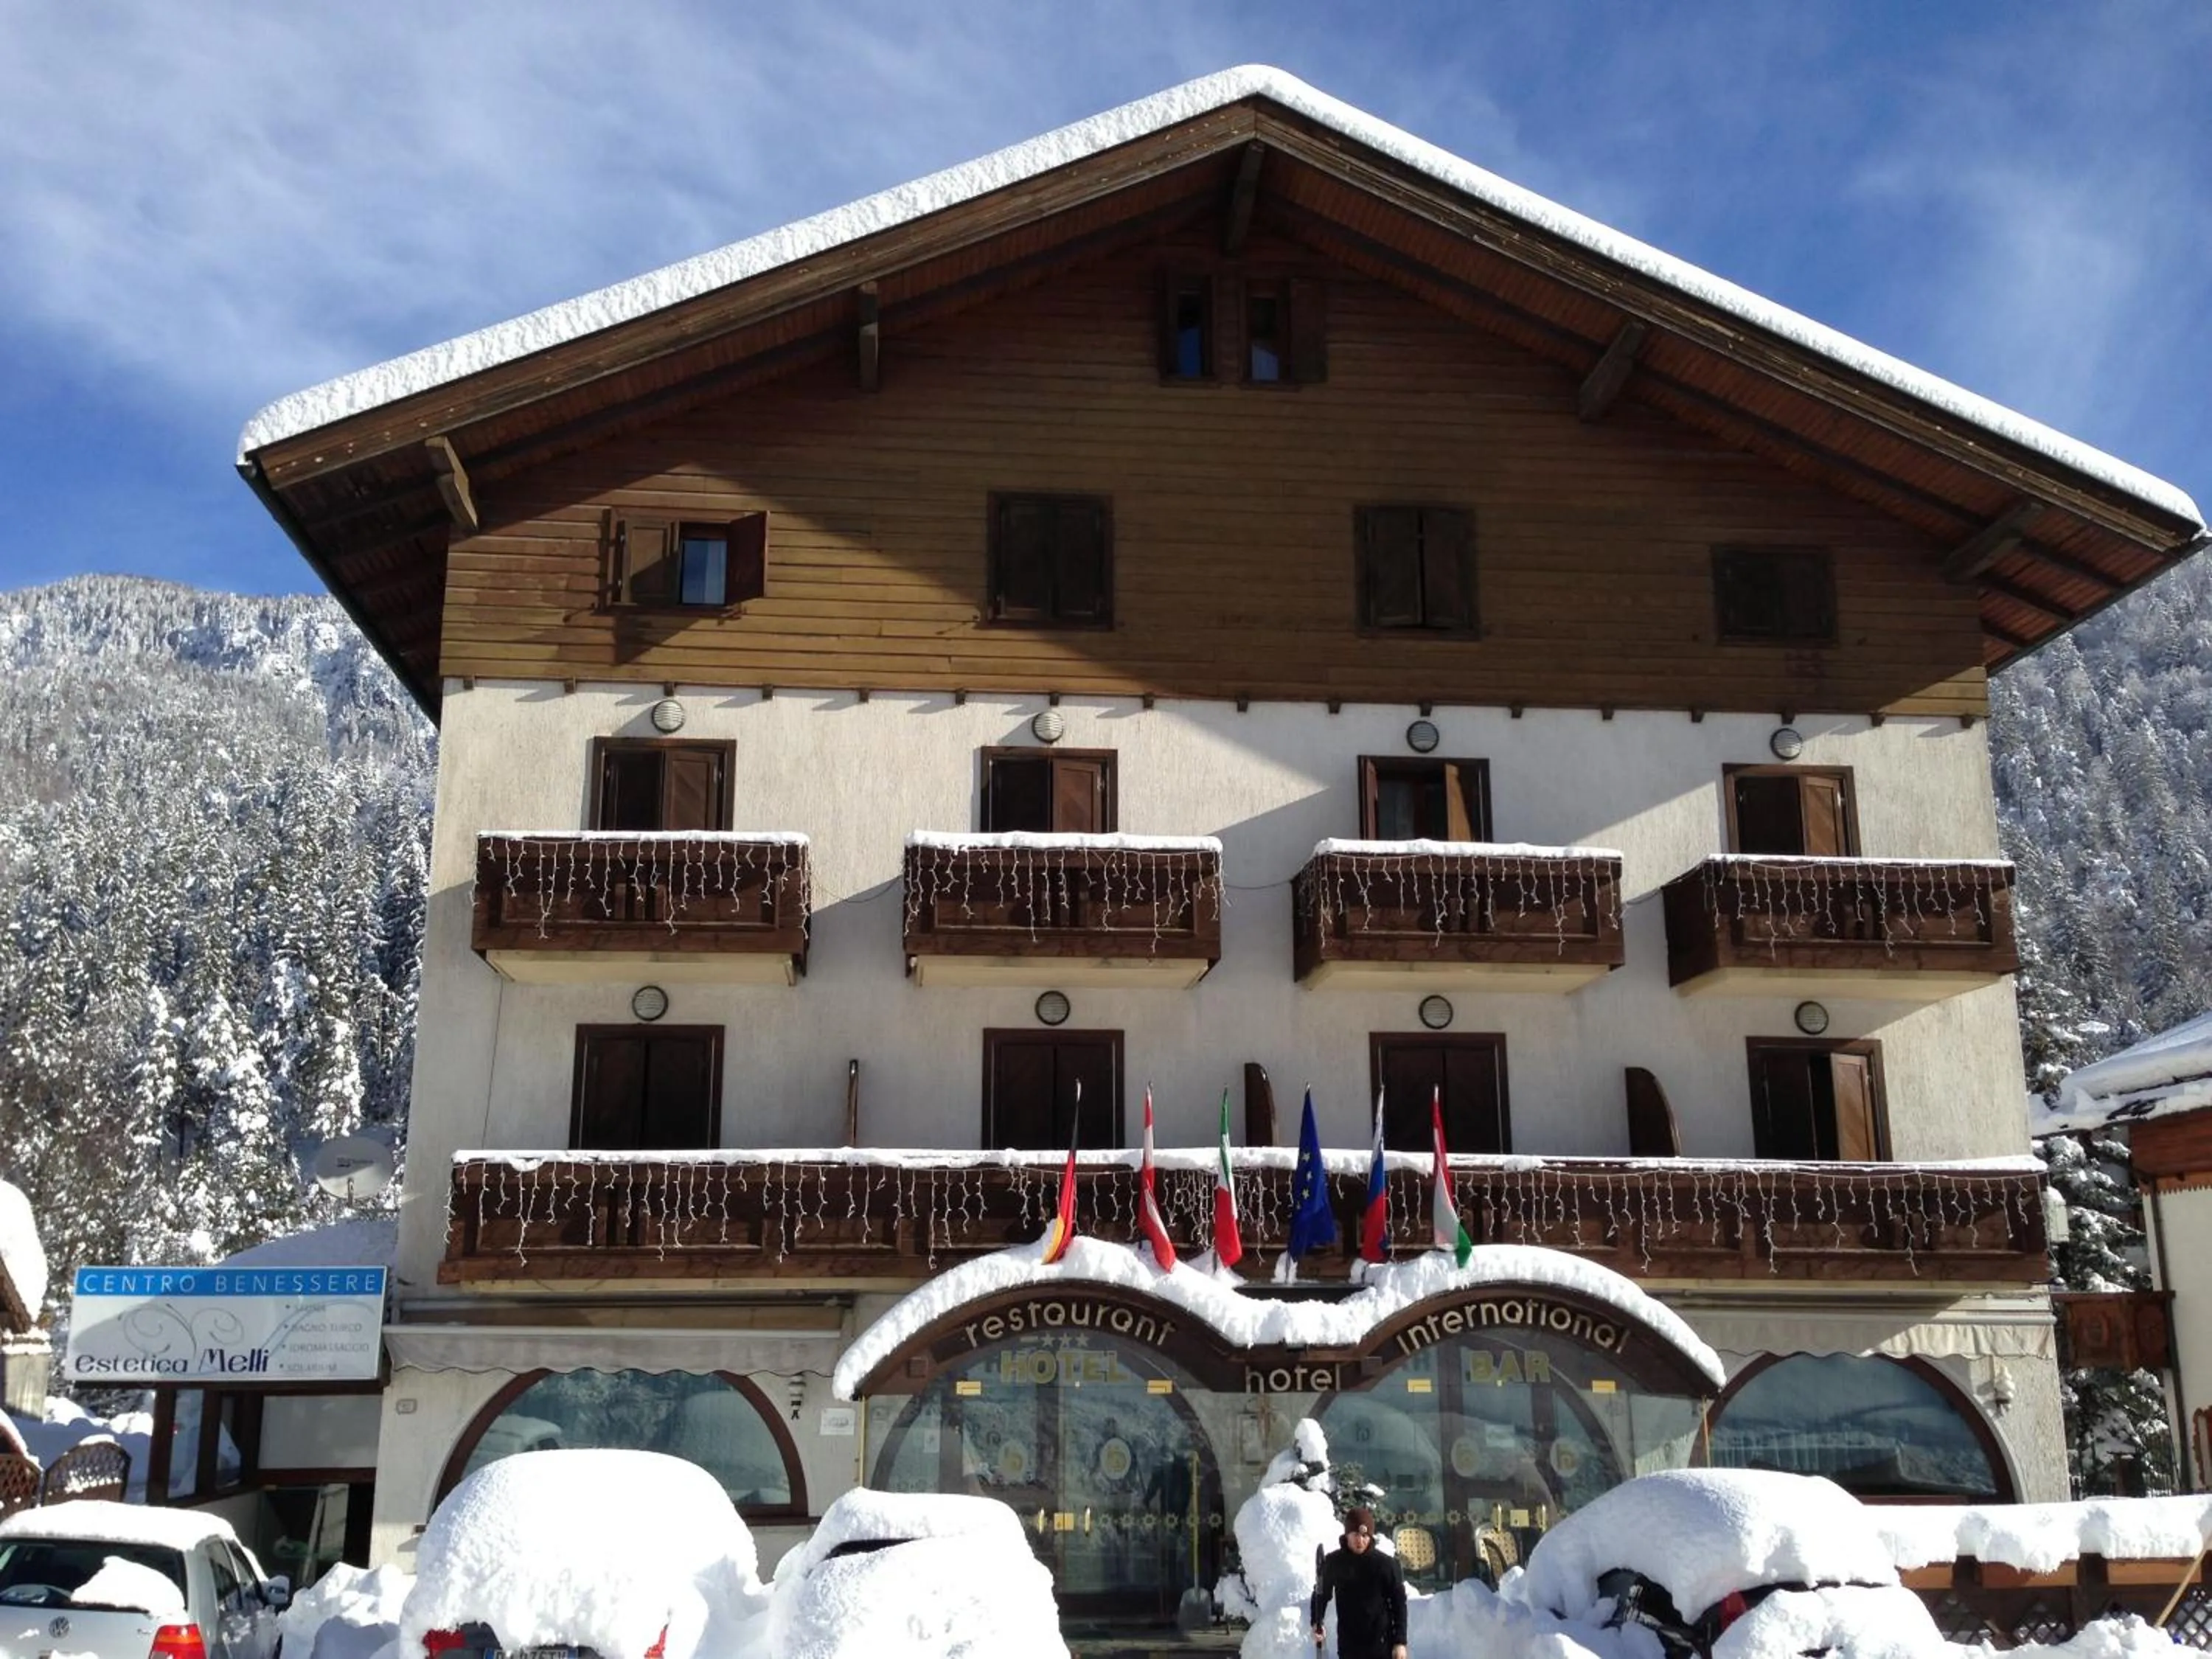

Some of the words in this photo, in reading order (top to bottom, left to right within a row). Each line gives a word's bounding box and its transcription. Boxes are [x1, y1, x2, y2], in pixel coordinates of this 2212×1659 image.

[83, 1274, 195, 1293] CENTRO
[215, 1273, 376, 1292] BENESSERE
[965, 1301, 1176, 1348] restaurant
[75, 1354, 188, 1373] estetica
[198, 1348, 269, 1373] Melli
[1000, 1349, 1130, 1385] HOTEL
[1470, 1350, 1551, 1383] BAR
[1245, 1363, 1340, 1394] hotel
